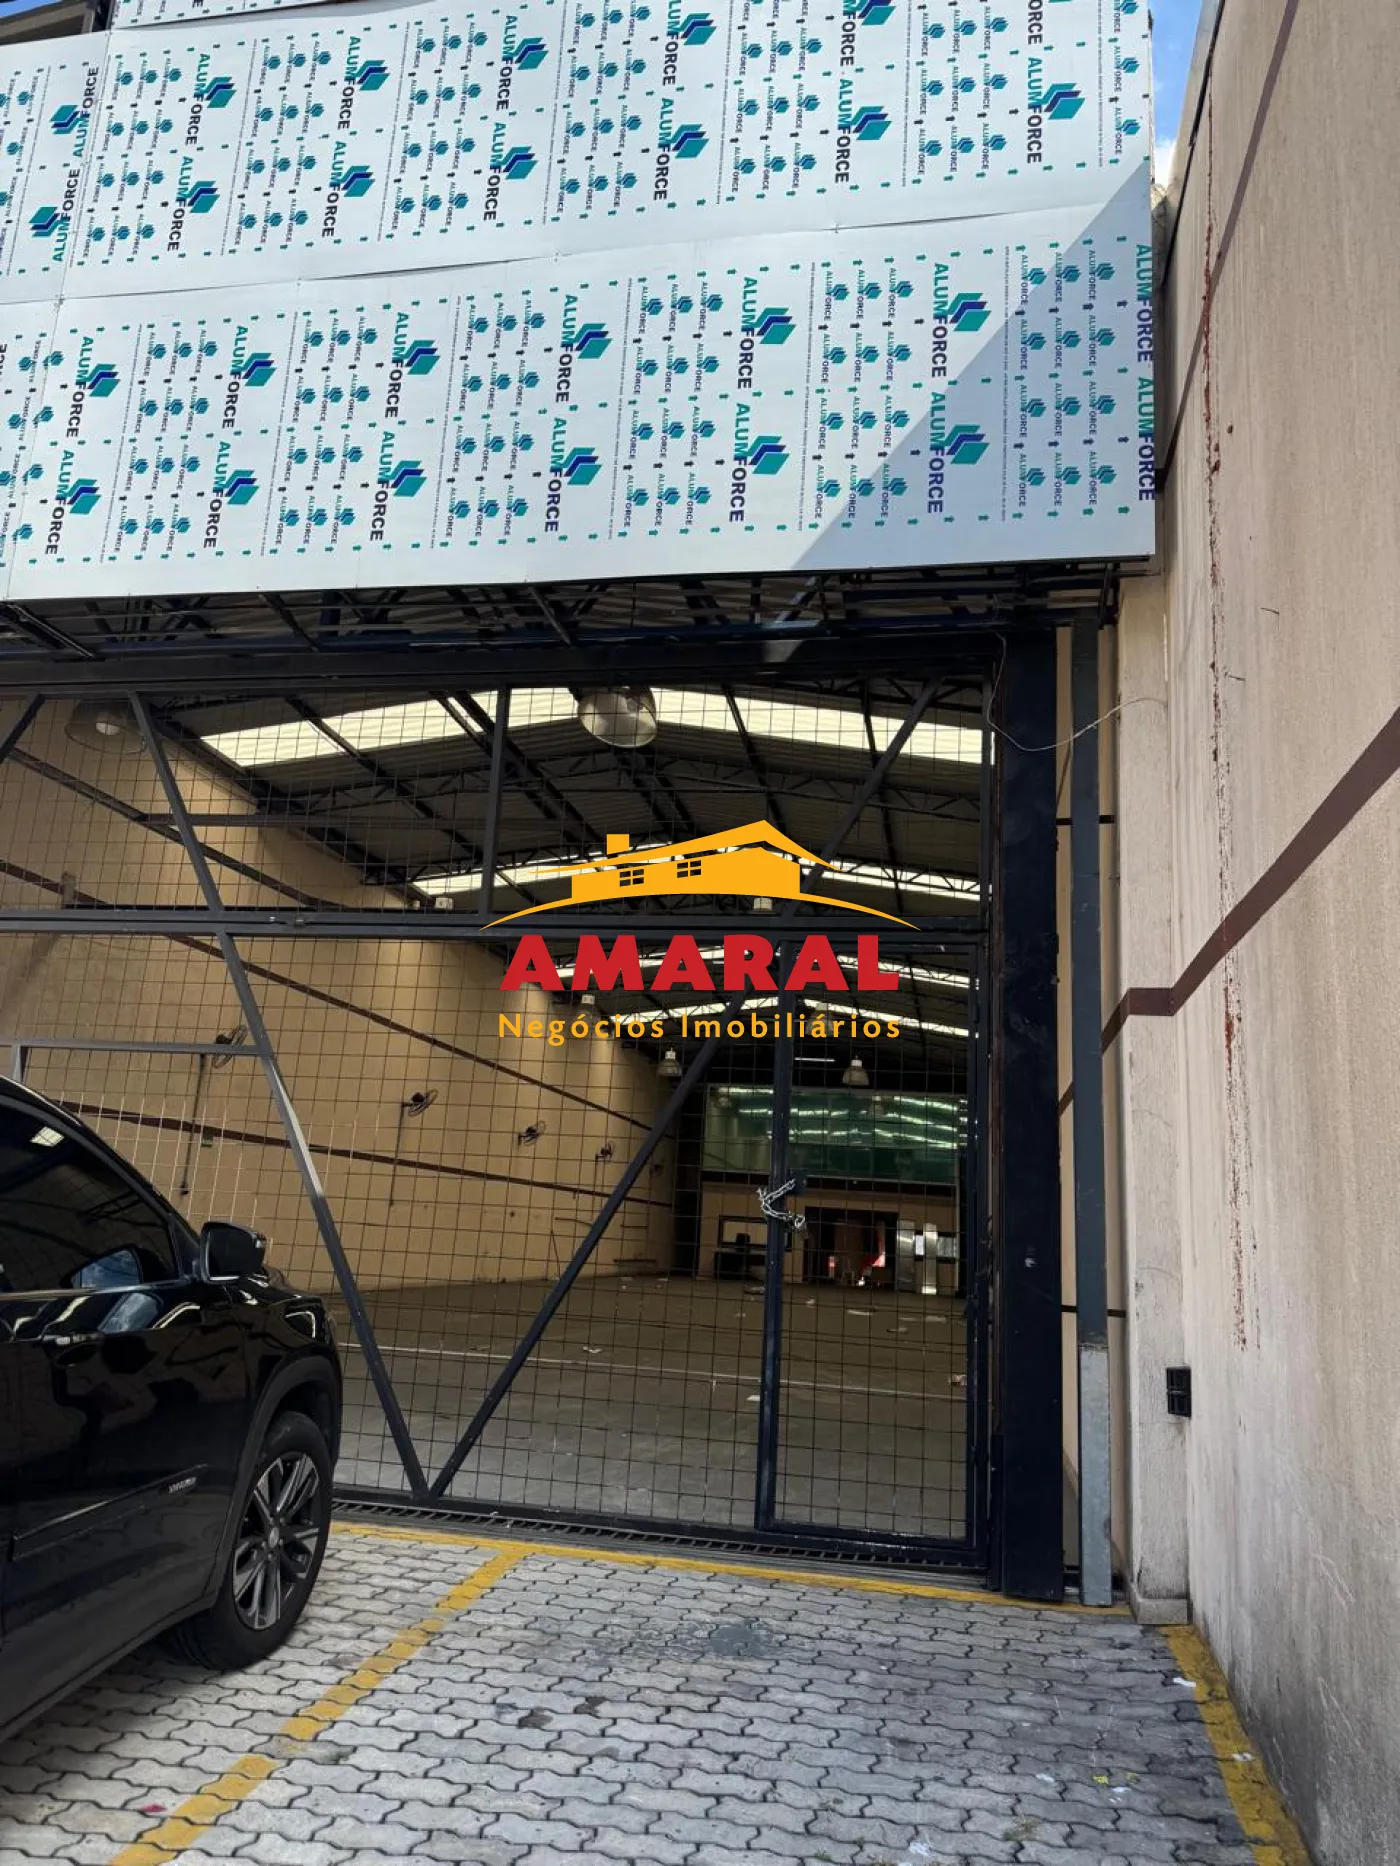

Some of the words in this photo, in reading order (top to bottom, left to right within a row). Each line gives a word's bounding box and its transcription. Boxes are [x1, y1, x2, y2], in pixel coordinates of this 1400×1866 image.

[72, 66, 99, 158] ALUMFORCE
[185, 54, 210, 146] ALUMFORCE
[337, 36, 362, 130] ALUMFORCE
[496, 15, 518, 111] ALUMFORCE
[1026, 56, 1043, 164] ALUMFORCE
[483, 122, 506, 221] ALUMFORCE
[653, 97, 674, 200] ALUMFORCE
[835, 78, 853, 183] ALUMFORCE
[52, 168, 81, 262] ALUMFORCE
[167, 156, 194, 252] ALUMFORCE
[322, 140, 347, 238] ALUMFORCE
[555, 294, 578, 403] ALUMFORCE
[738, 277, 758, 389] ALUMFORCE
[932, 262, 950, 378] ALUMFORCE
[1136, 244, 1153, 363] ALUMFORCE
[66, 336, 94, 438] ALUMFORCE
[222, 325, 248, 429] ALUMFORCE
[385, 312, 410, 418] ALUMFORCE
[370, 431, 395, 541] ALUMFORCE
[544, 417, 567, 532] ALUMFORCE
[729, 402, 751, 522] ALUMFORCE
[928, 392, 946, 513] ALUMFORCE
[1138, 377, 1156, 501] ALUMFORCE
[45, 449, 75, 554] ALUMFORCE
[204, 441, 231, 548] ALUMFORCE
